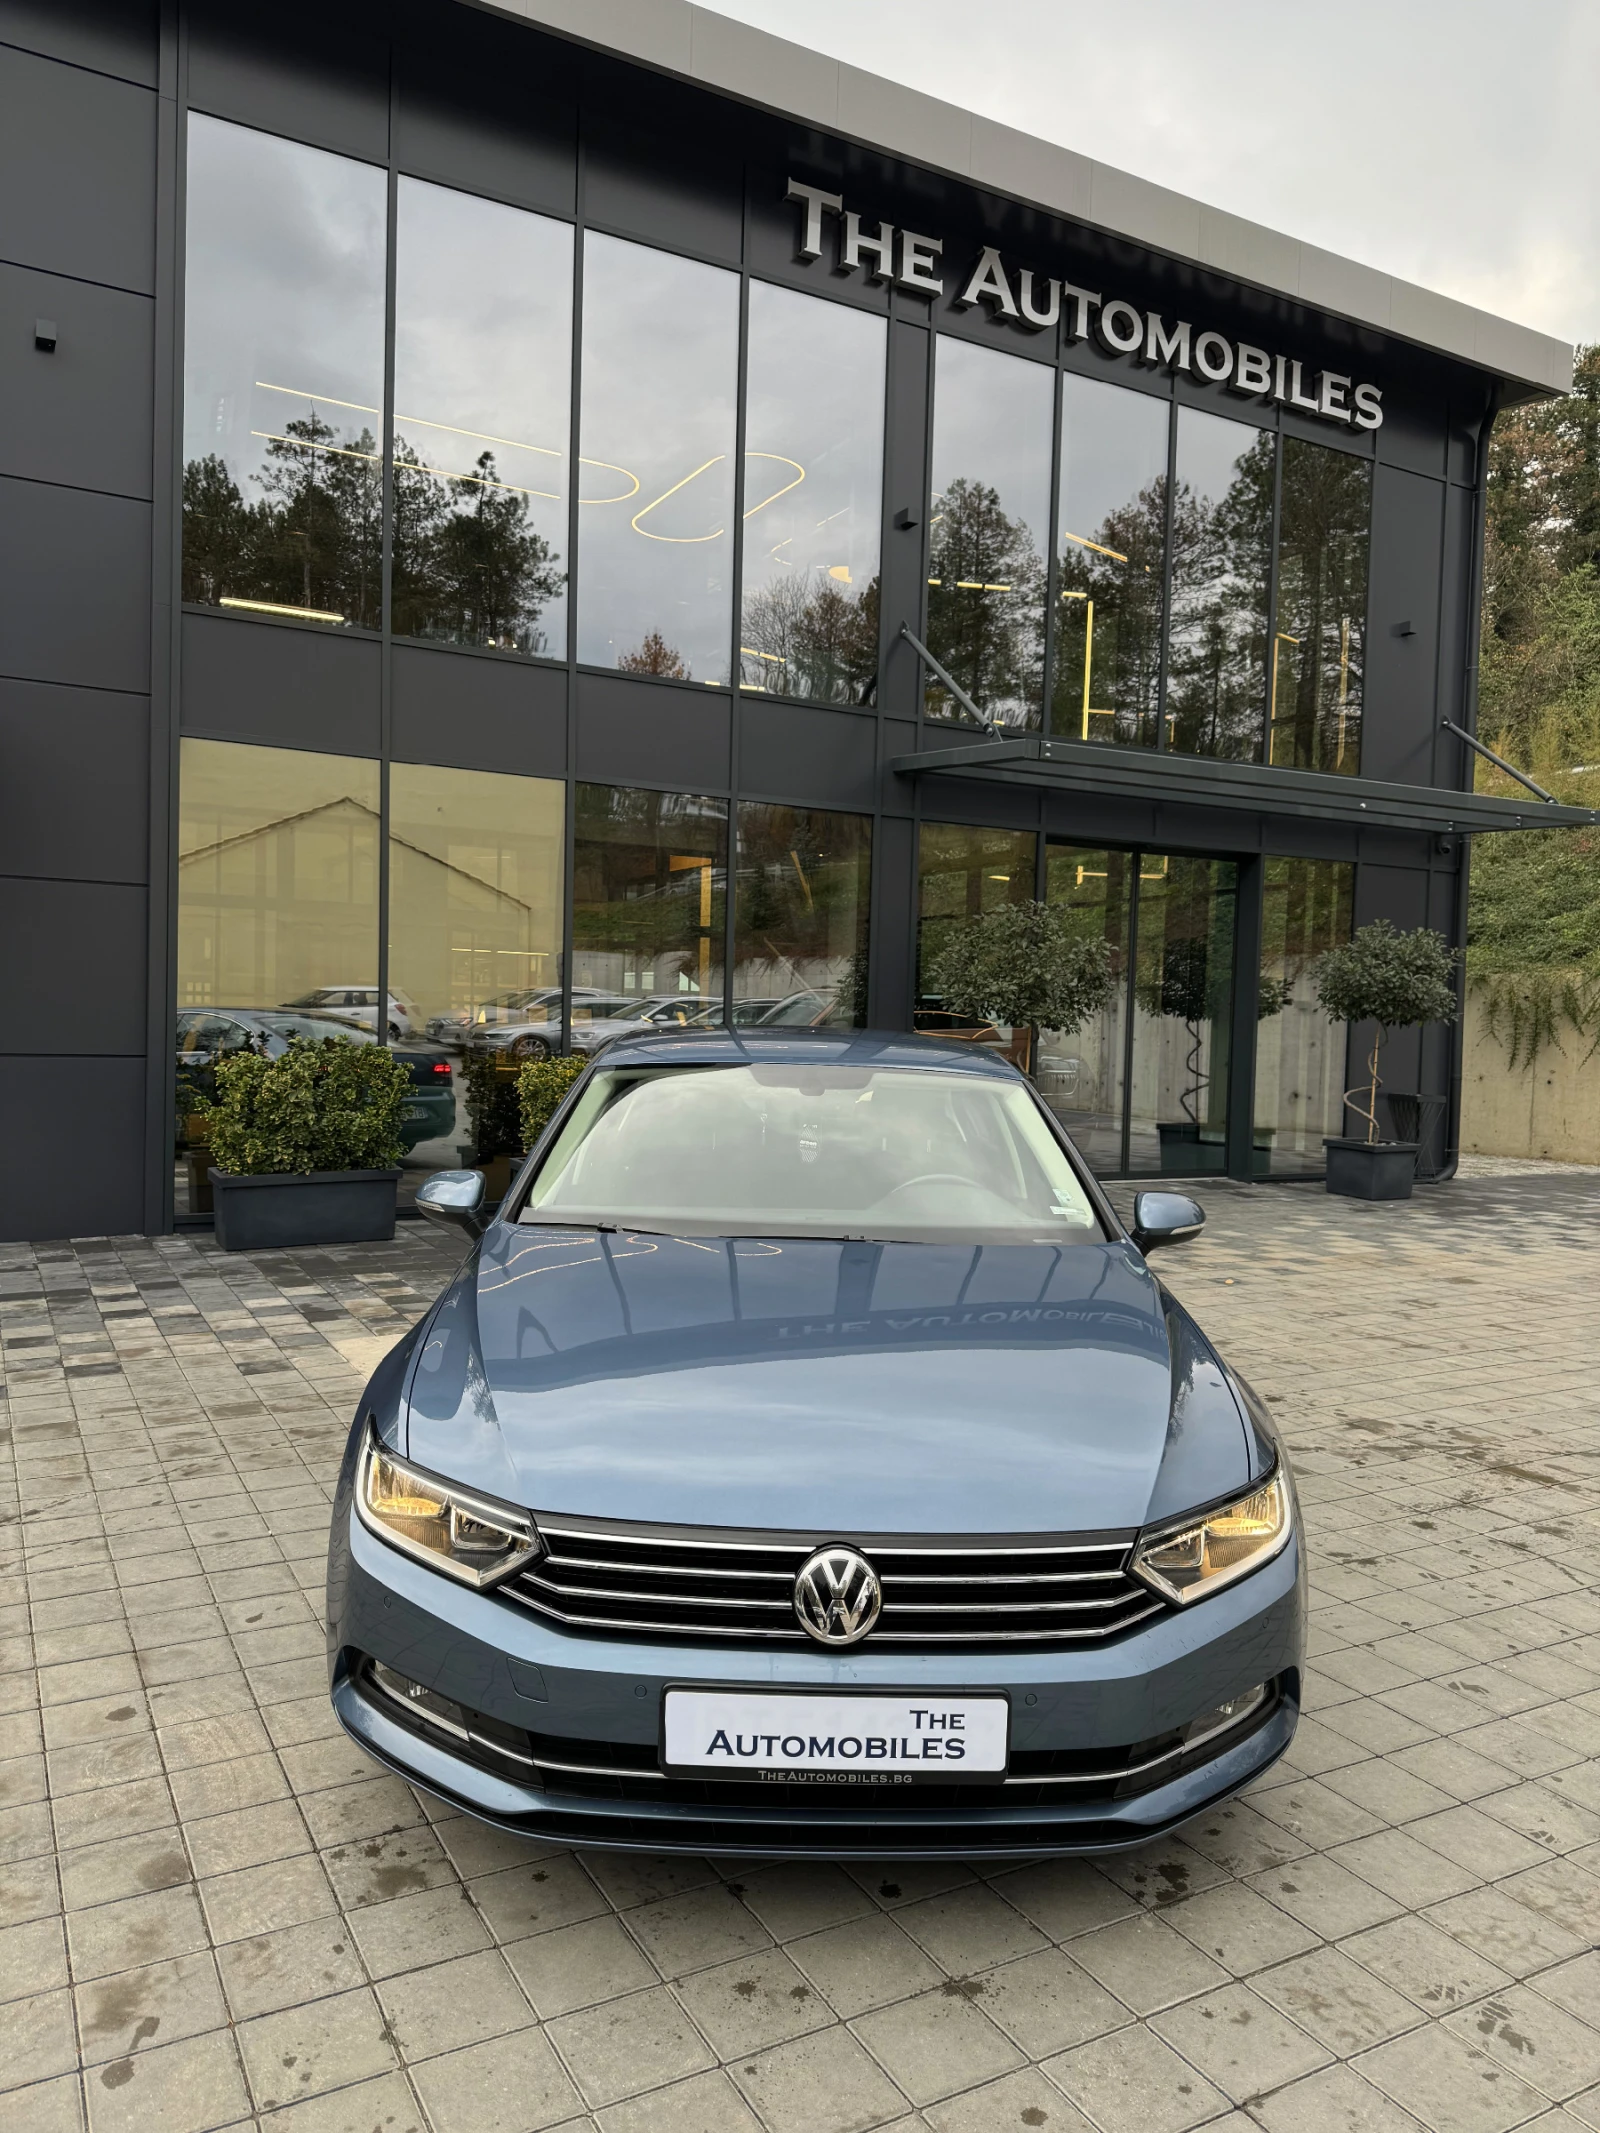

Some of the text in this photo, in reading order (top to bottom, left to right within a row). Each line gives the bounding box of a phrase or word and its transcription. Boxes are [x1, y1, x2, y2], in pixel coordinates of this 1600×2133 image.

[784, 177, 1384, 431] THE AUTOMOBILES
[799, 1552, 878, 1641] VW
[909, 1709, 965, 1730] THE
[705, 1729, 966, 1760] AUTOMOBILES
[758, 1770, 912, 1783] THEAUTOMOBILES.BG
